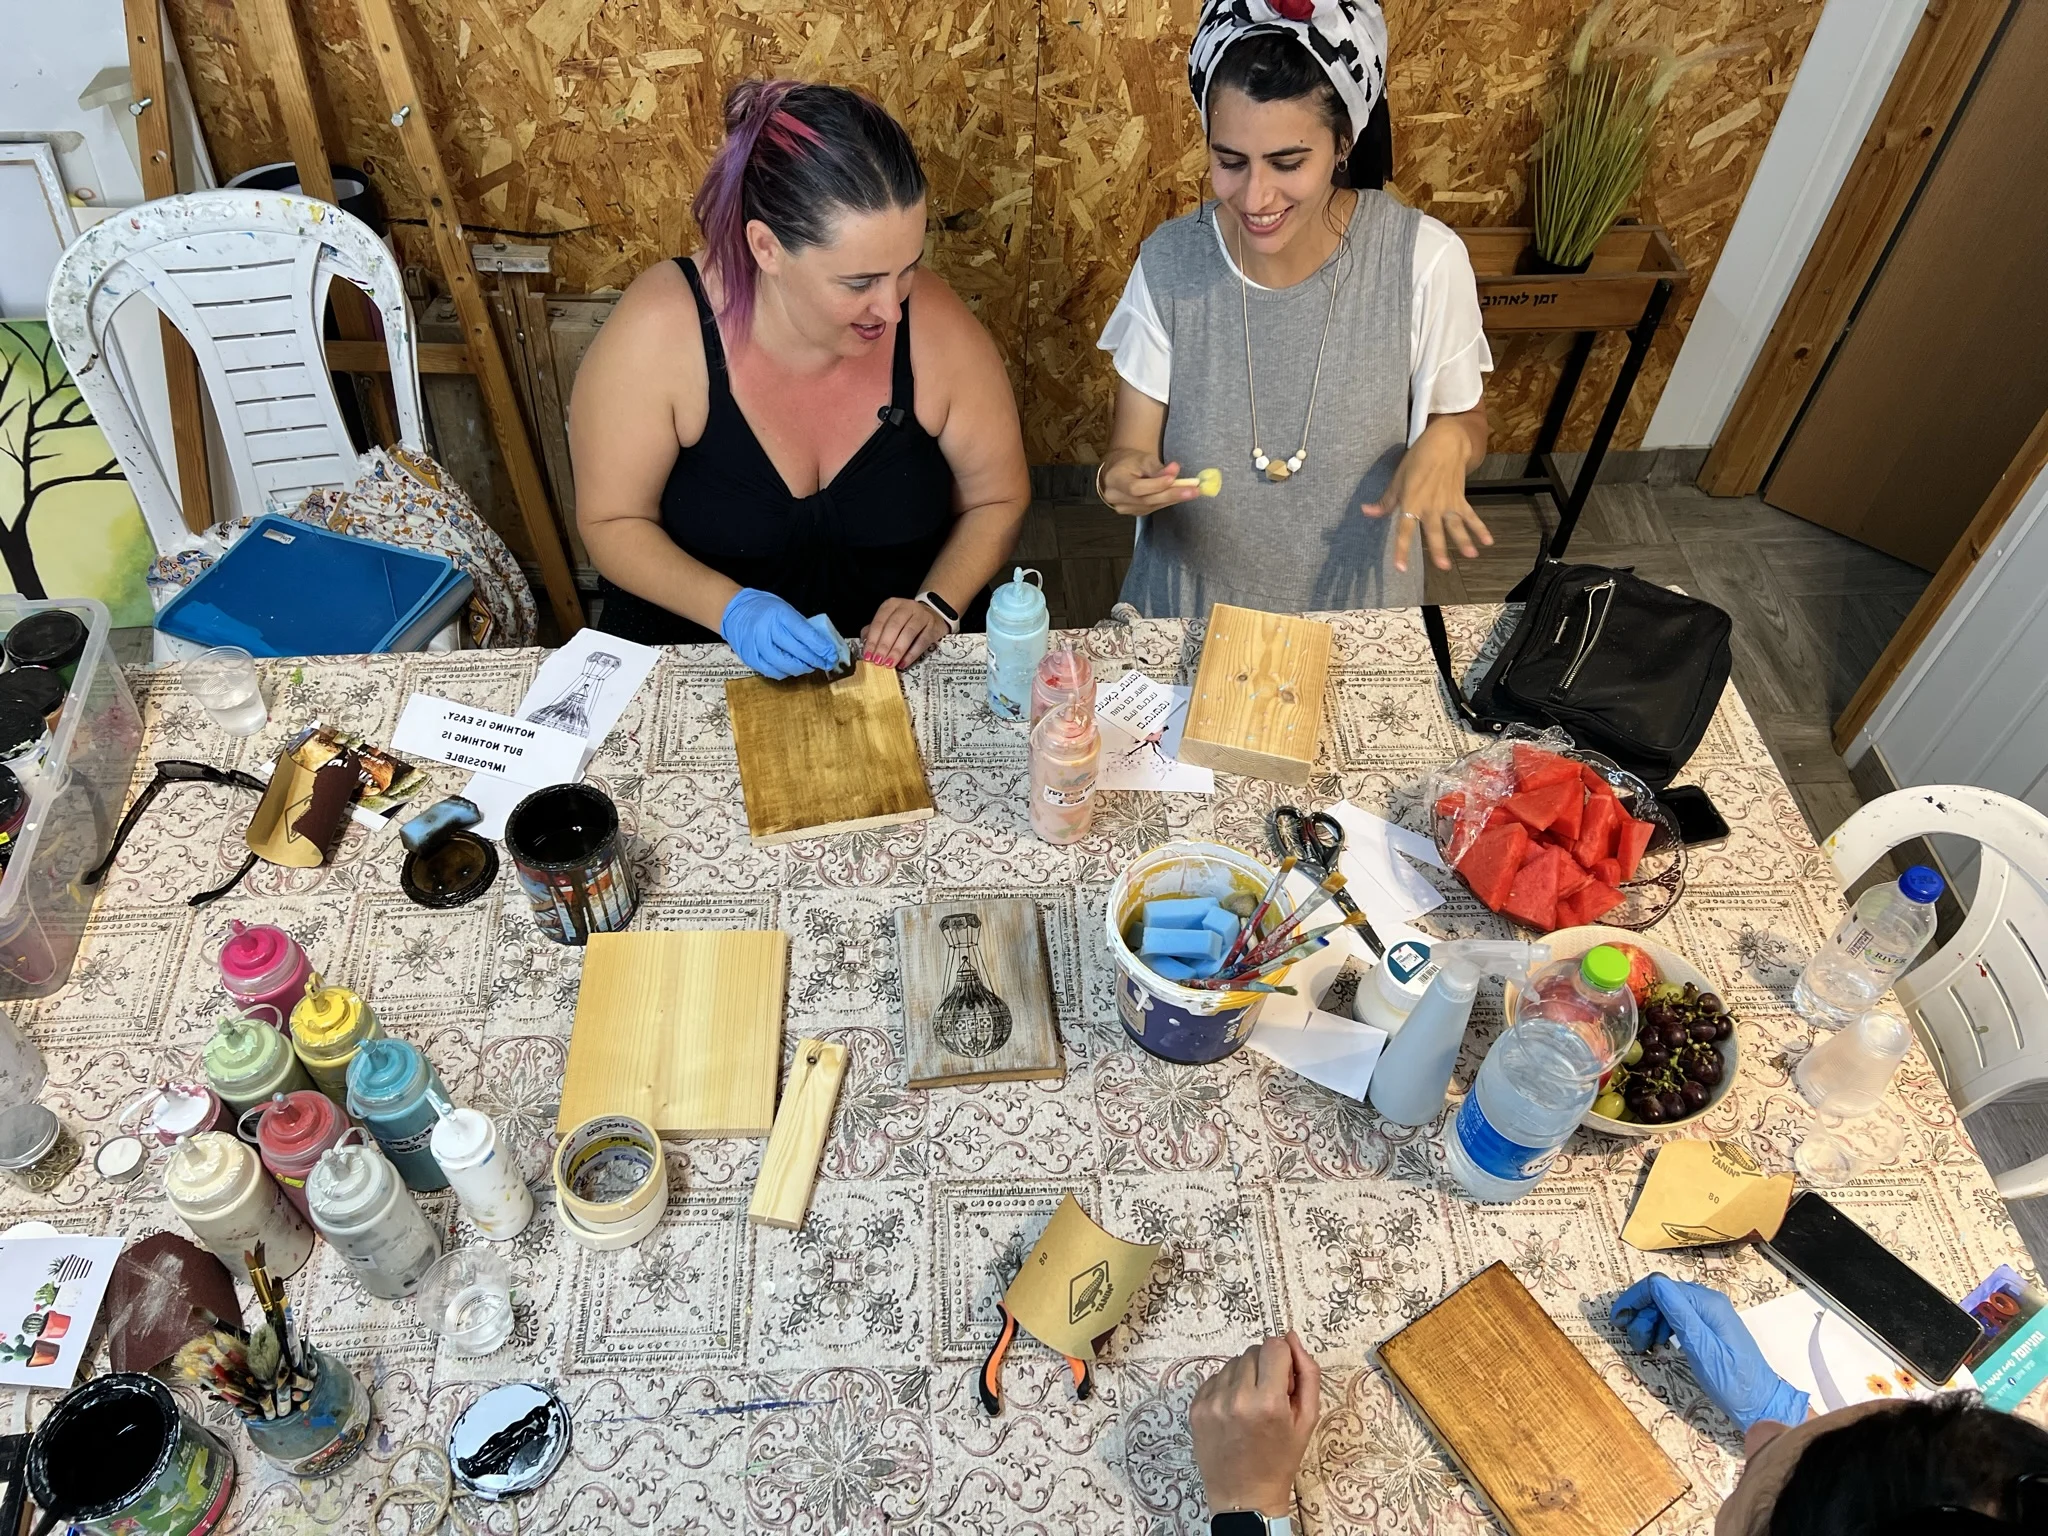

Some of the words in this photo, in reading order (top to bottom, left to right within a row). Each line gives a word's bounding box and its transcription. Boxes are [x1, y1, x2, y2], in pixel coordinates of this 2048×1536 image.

[1481, 291, 1529, 306] לאהוב
[1533, 292, 1559, 307] זמן
[1875, 952, 1907, 964] RIVER
[1707, 1192, 1721, 1204] 80
[1038, 1251, 1050, 1267] 80
